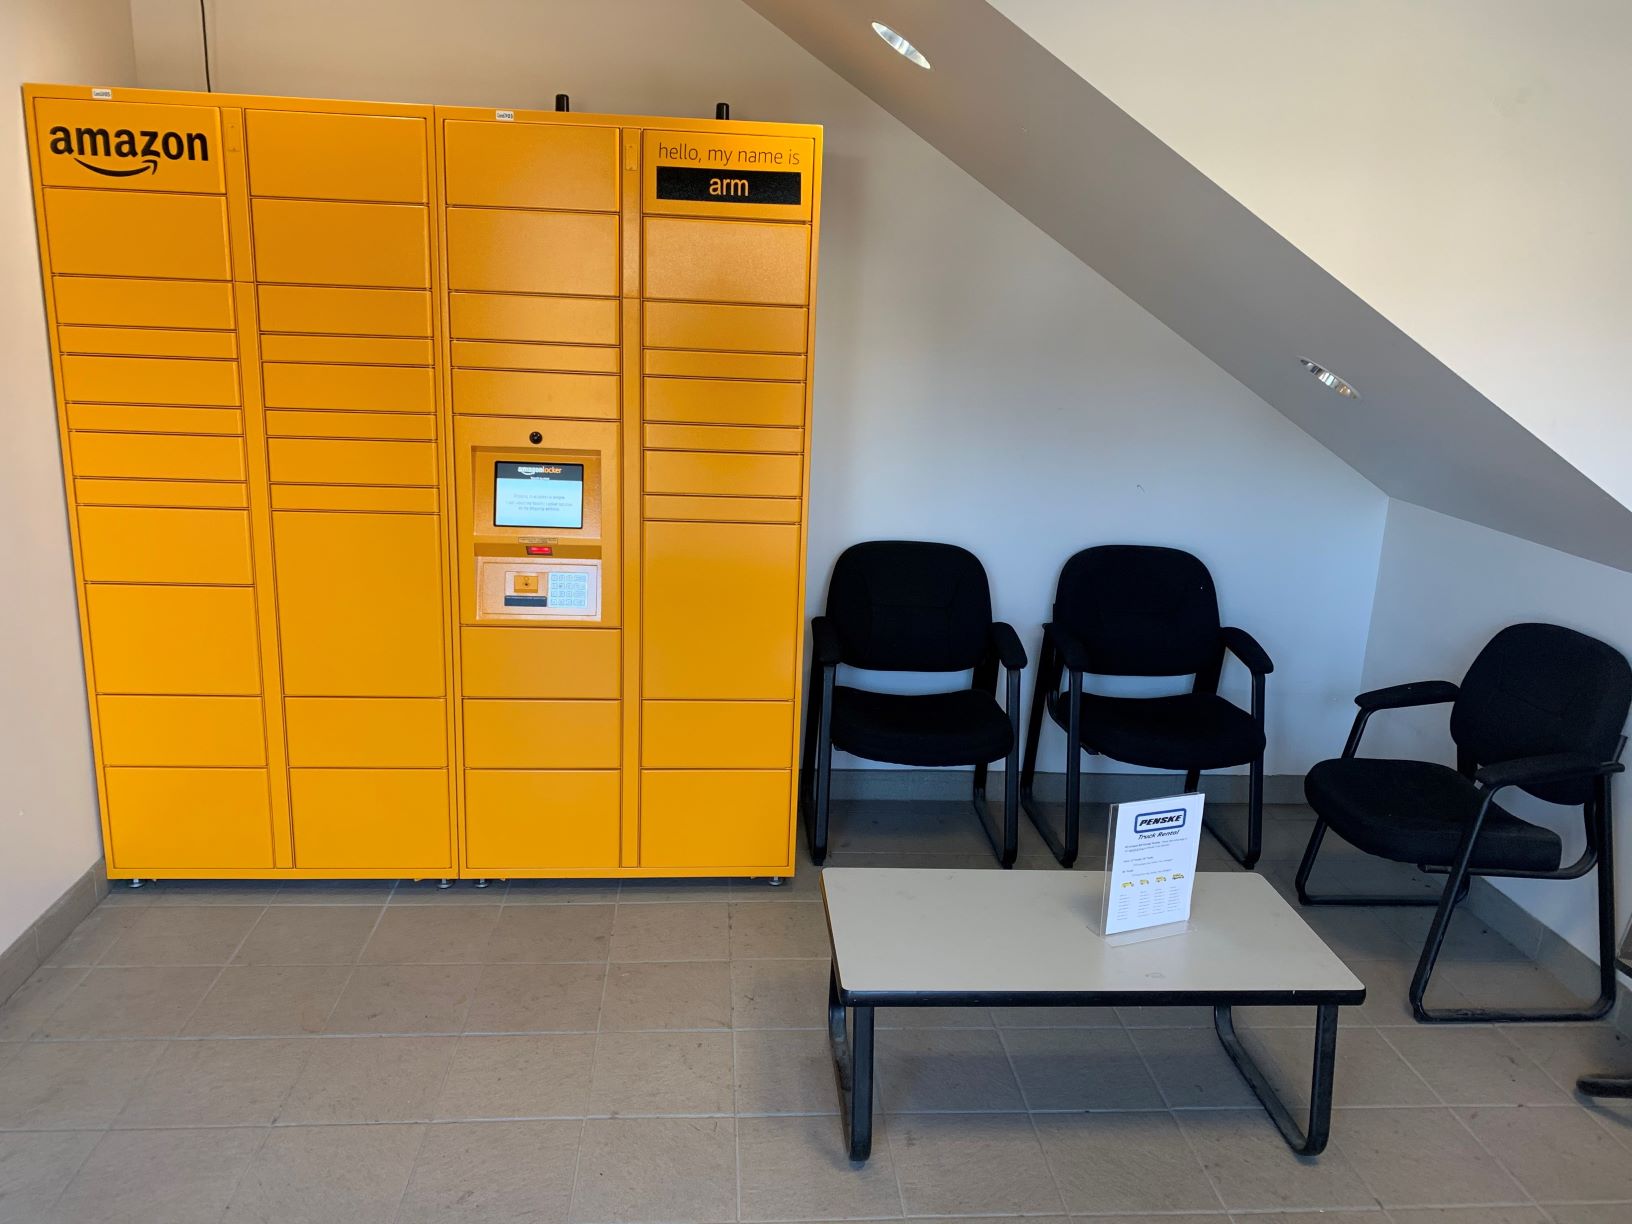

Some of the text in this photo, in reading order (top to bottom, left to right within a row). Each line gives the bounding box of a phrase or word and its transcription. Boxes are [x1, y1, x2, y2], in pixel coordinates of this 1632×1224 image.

[49, 125, 209, 162] amazon
[658, 141, 800, 166] hello, my name is
[709, 177, 749, 197] arm
[1138, 814, 1183, 827] PENSKE
[1138, 830, 1180, 840] Truck Rental
